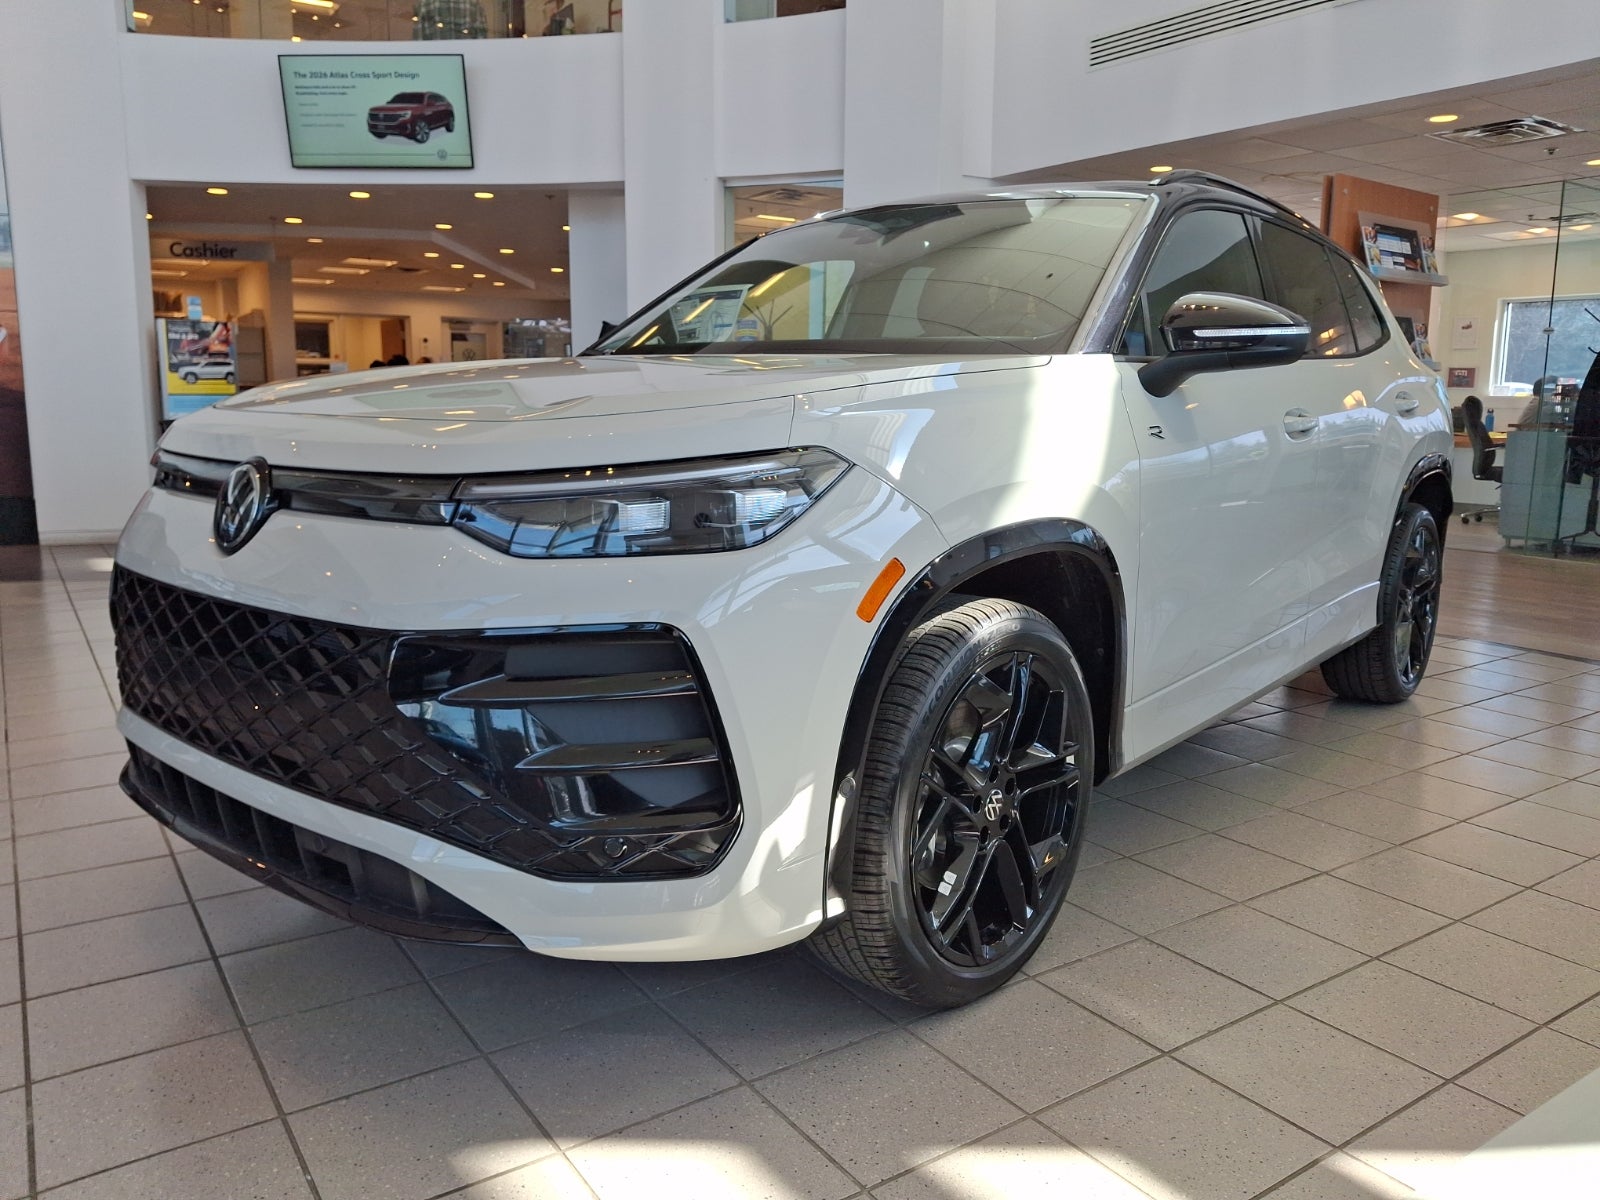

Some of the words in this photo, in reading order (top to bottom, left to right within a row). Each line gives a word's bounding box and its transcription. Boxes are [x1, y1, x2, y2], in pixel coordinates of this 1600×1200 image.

[293, 71, 307, 79] The
[309, 71, 328, 79] 2026
[329, 71, 349, 79] Atlas
[350, 71, 371, 79] Cross
[372, 71, 392, 80] Sport
[394, 71, 420, 80] Design
[170, 242, 237, 258] Cashier
